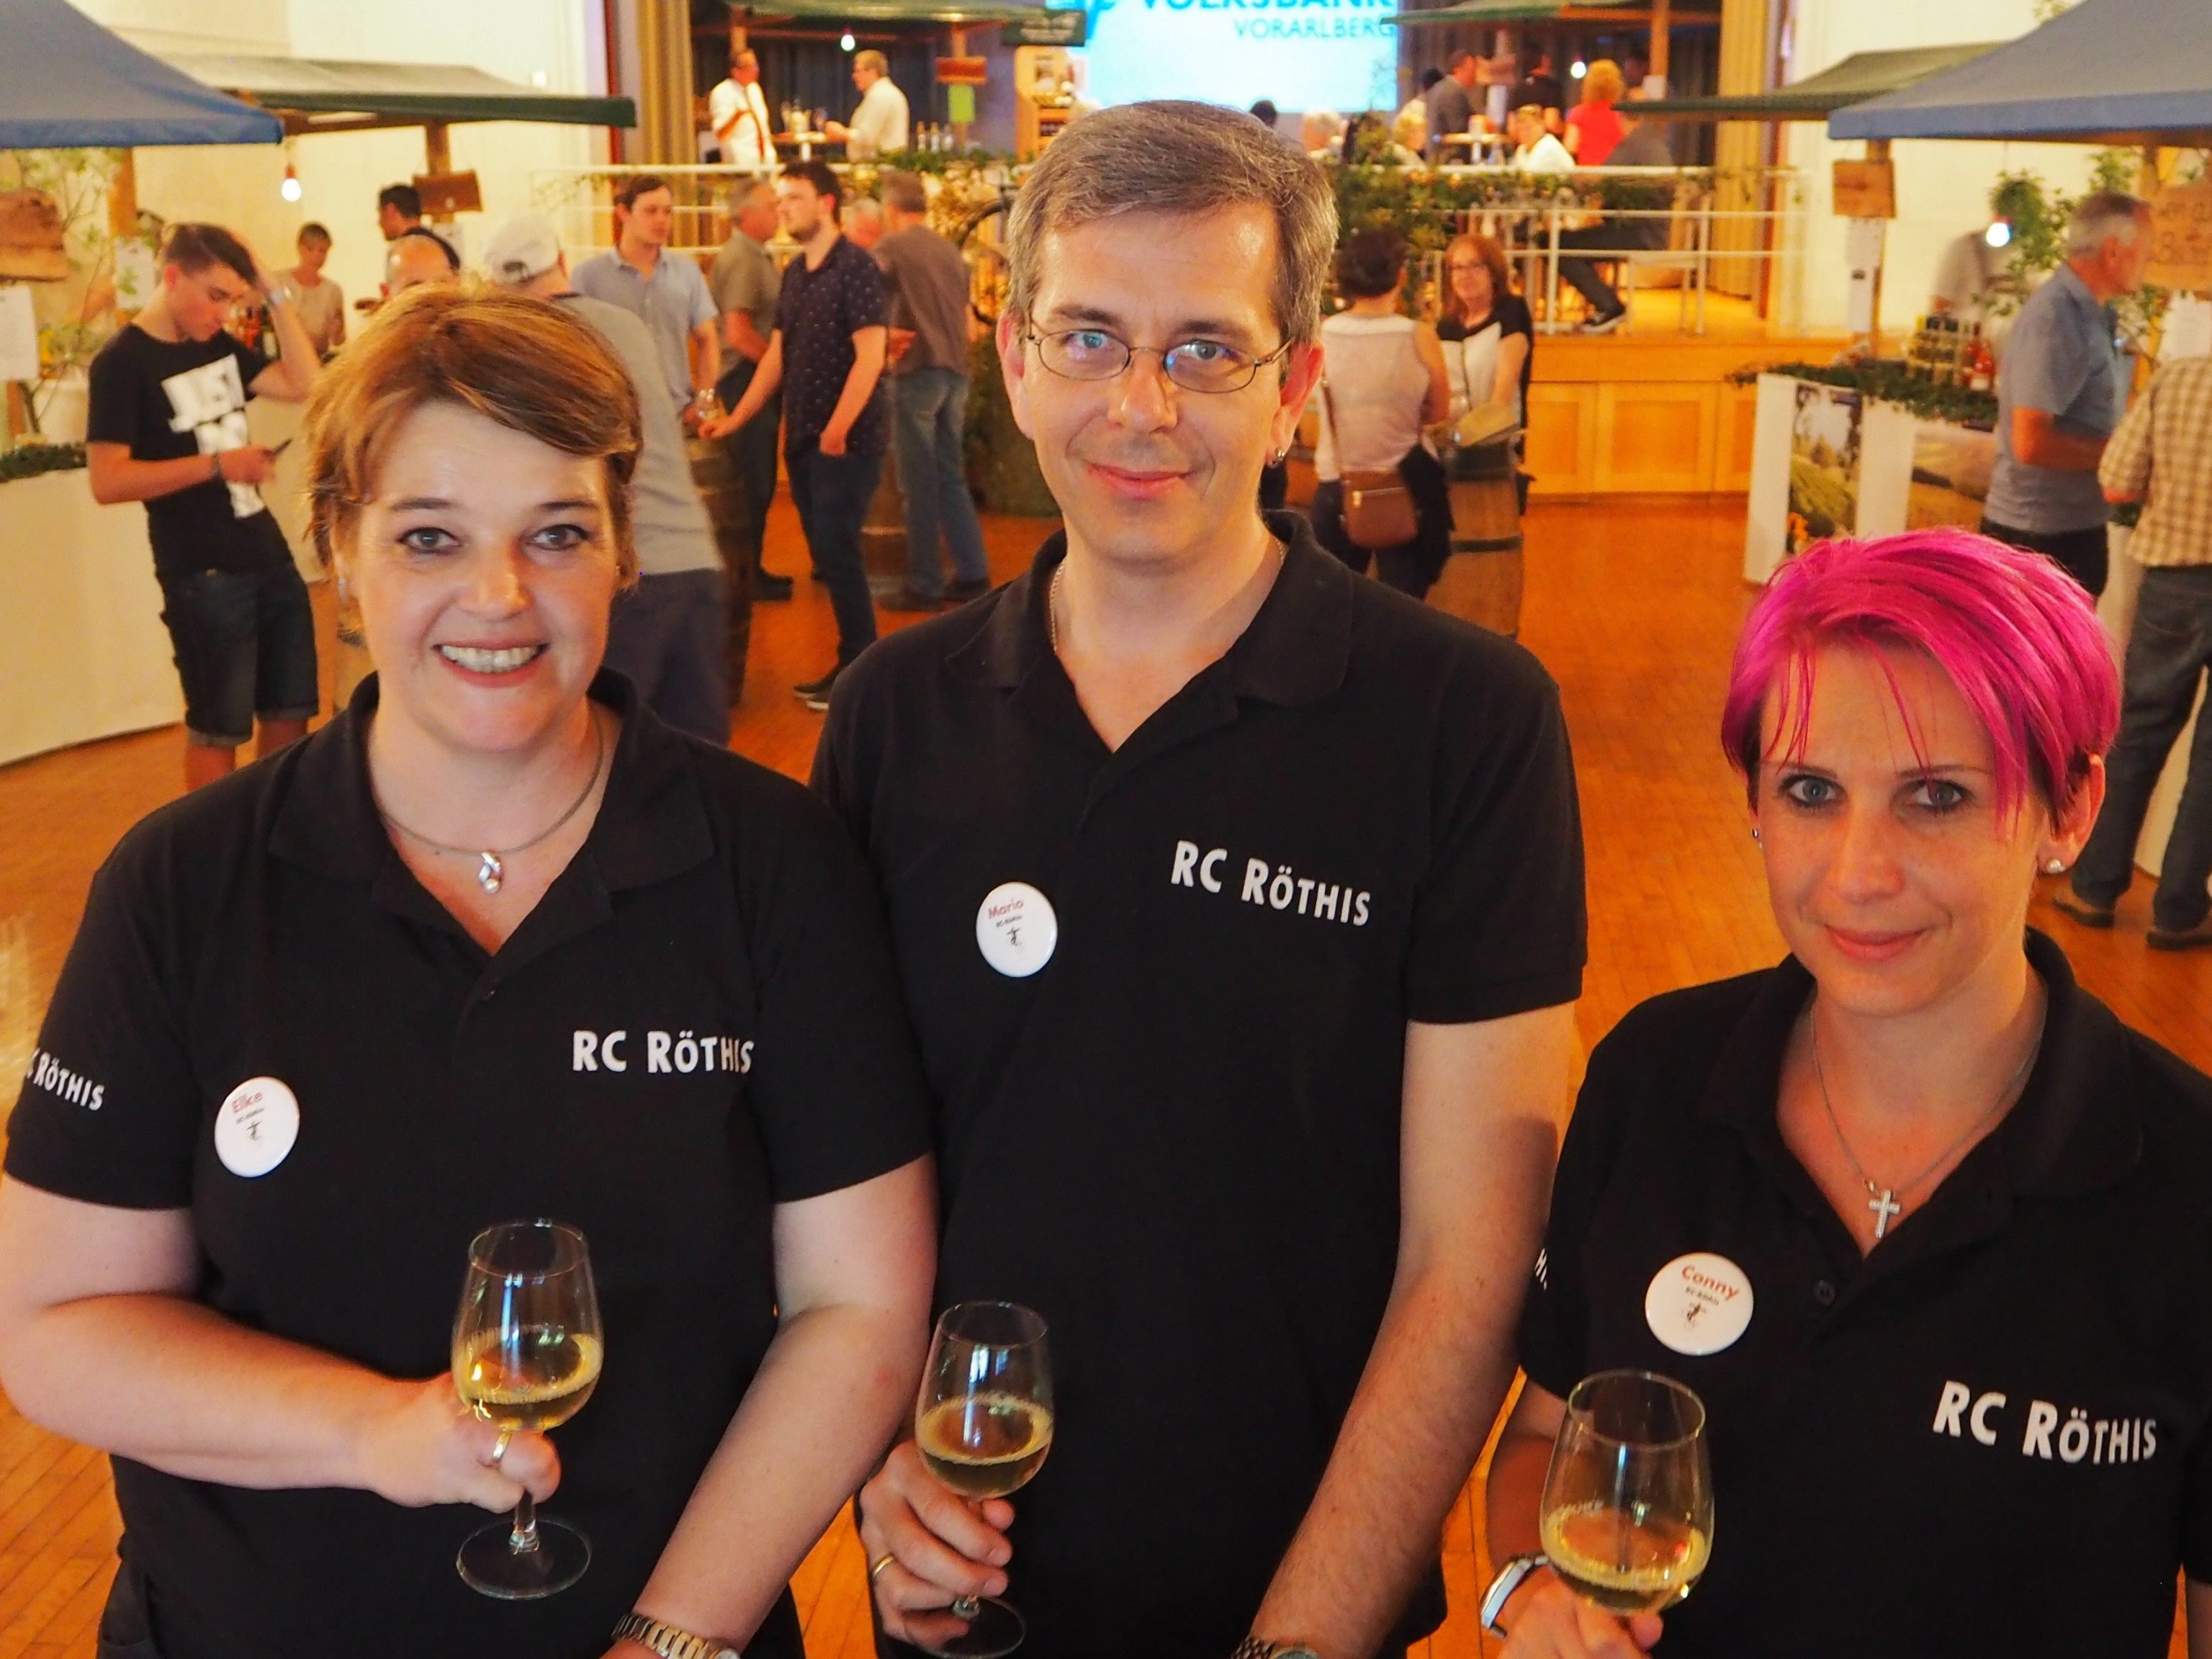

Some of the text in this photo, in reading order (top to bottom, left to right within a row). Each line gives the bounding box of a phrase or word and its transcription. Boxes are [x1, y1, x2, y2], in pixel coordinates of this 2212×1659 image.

[1234, 15, 1394, 37] VORARLBERG
[1171, 840, 1370, 925] RC RÖTHIS
[988, 898, 1025, 920] Mario
[573, 1030, 754, 1073] RC RÖTHIS
[32, 1051, 105, 1111] RÖTHIS
[1681, 1264, 1740, 1302] Conny
[1933, 1381, 2156, 1463] RC RÖTHIS
